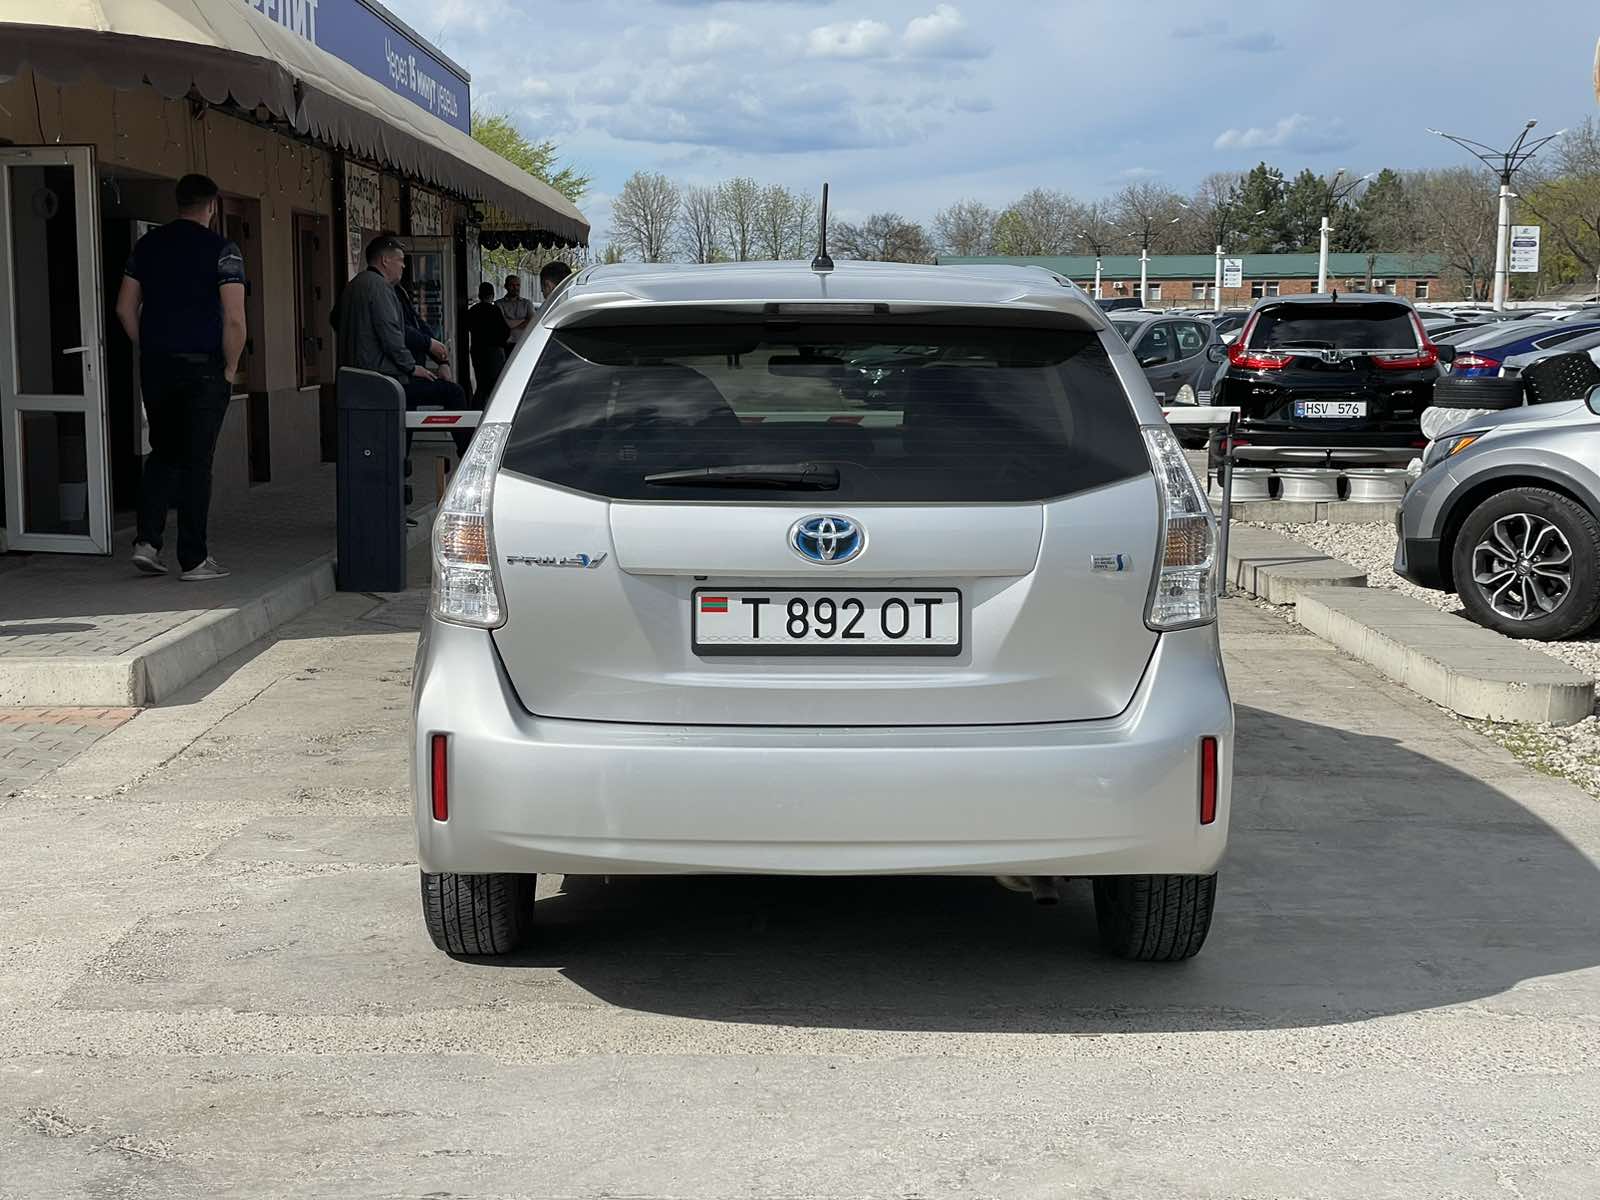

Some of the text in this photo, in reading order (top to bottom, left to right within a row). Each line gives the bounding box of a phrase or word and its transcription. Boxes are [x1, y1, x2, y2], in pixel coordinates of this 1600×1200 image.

[1306, 403, 1329, 414] HSV
[1338, 403, 1359, 414] 576
[741, 598, 943, 638] T 892 OT
